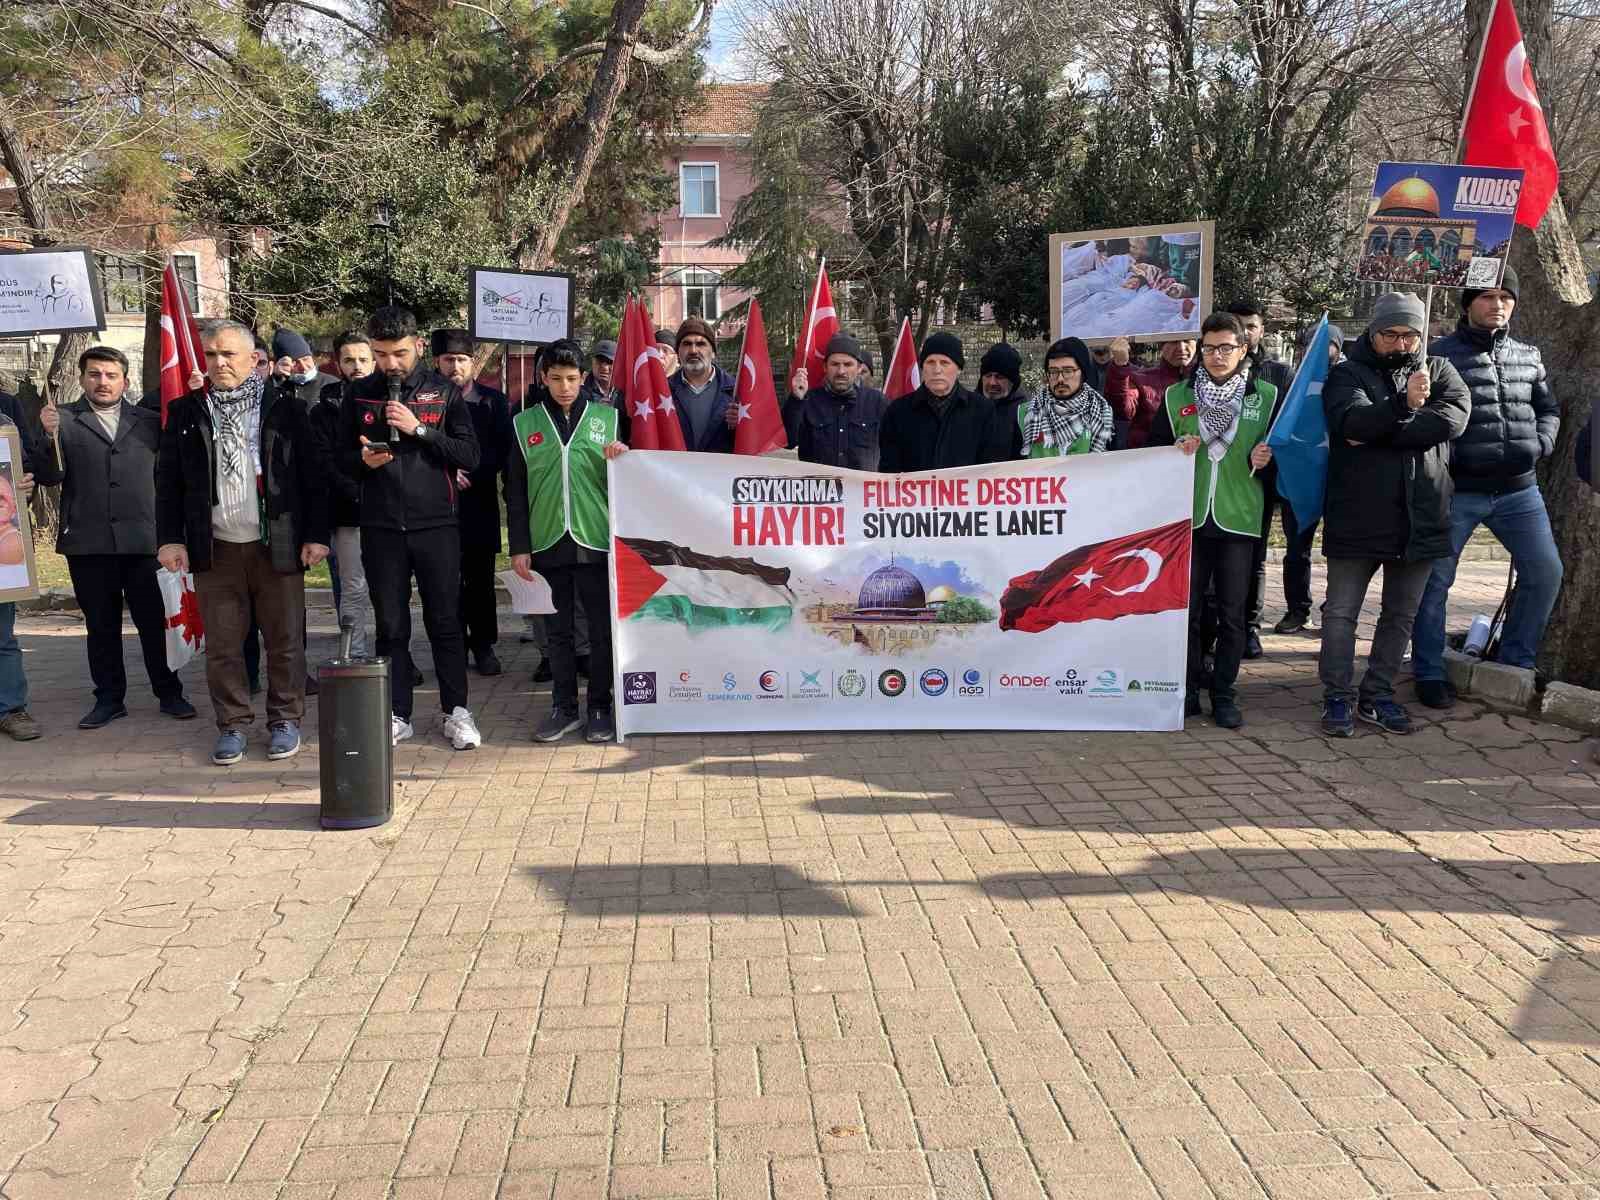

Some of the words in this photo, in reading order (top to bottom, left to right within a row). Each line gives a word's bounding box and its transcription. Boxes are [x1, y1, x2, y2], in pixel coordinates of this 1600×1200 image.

[737, 478, 839, 502] SOYKIRIMA
[977, 476, 1067, 505] DESTEK
[733, 506, 845, 546] HAYIR!
[863, 507, 988, 538] SİYONİZME
[996, 510, 1067, 536] LANET
